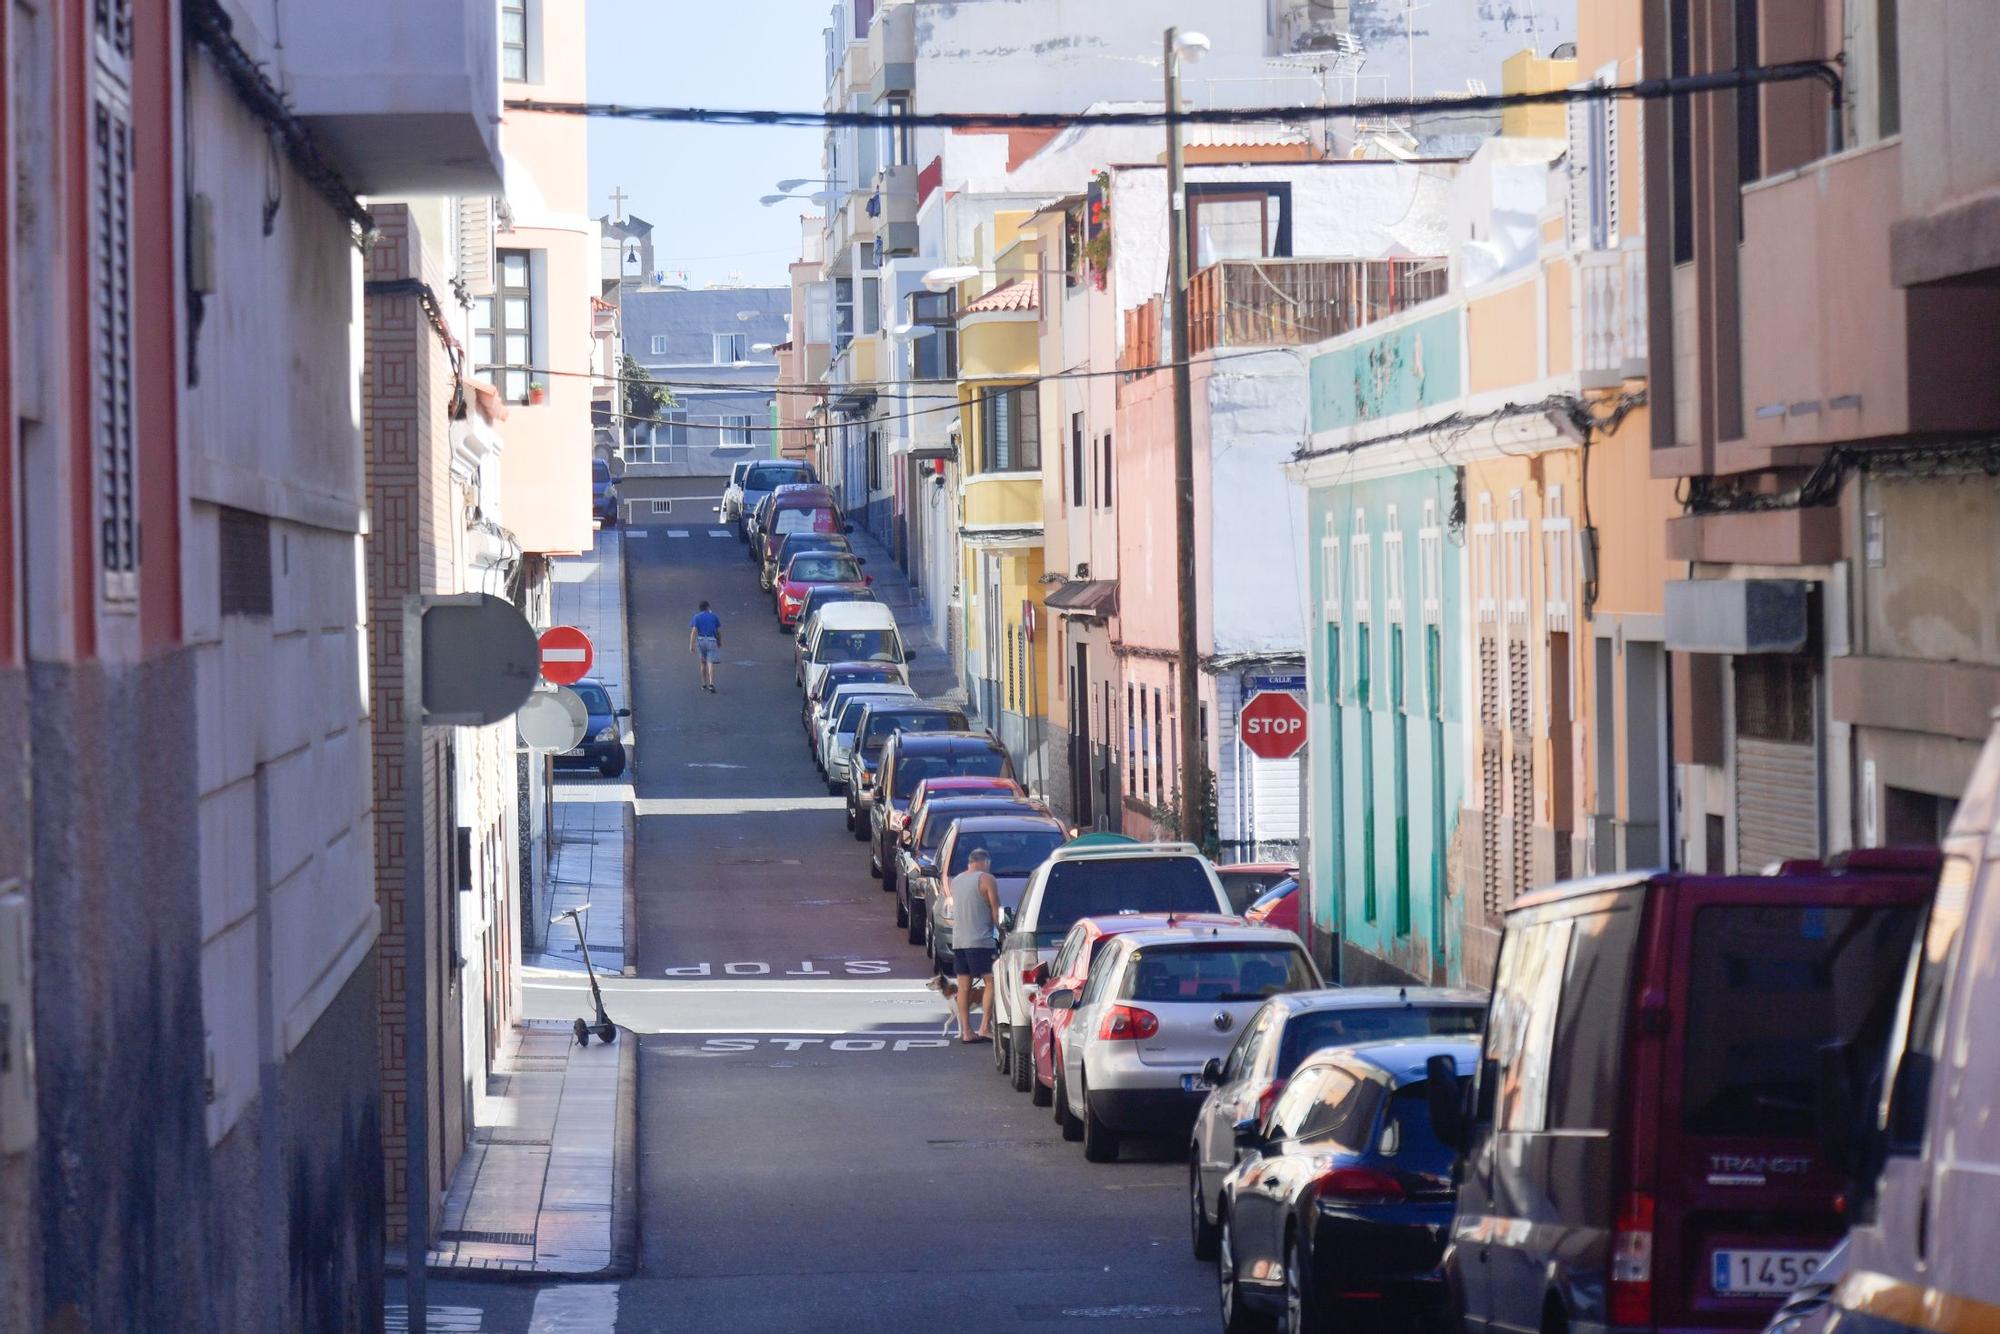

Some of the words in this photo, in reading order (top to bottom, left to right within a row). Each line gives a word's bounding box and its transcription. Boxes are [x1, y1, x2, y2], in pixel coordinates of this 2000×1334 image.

[1248, 718, 1302, 734] STOP
[665, 961, 891, 976] STOP
[700, 1038, 950, 1052] STOP
[1710, 1156, 1811, 1174] TRANSIT
